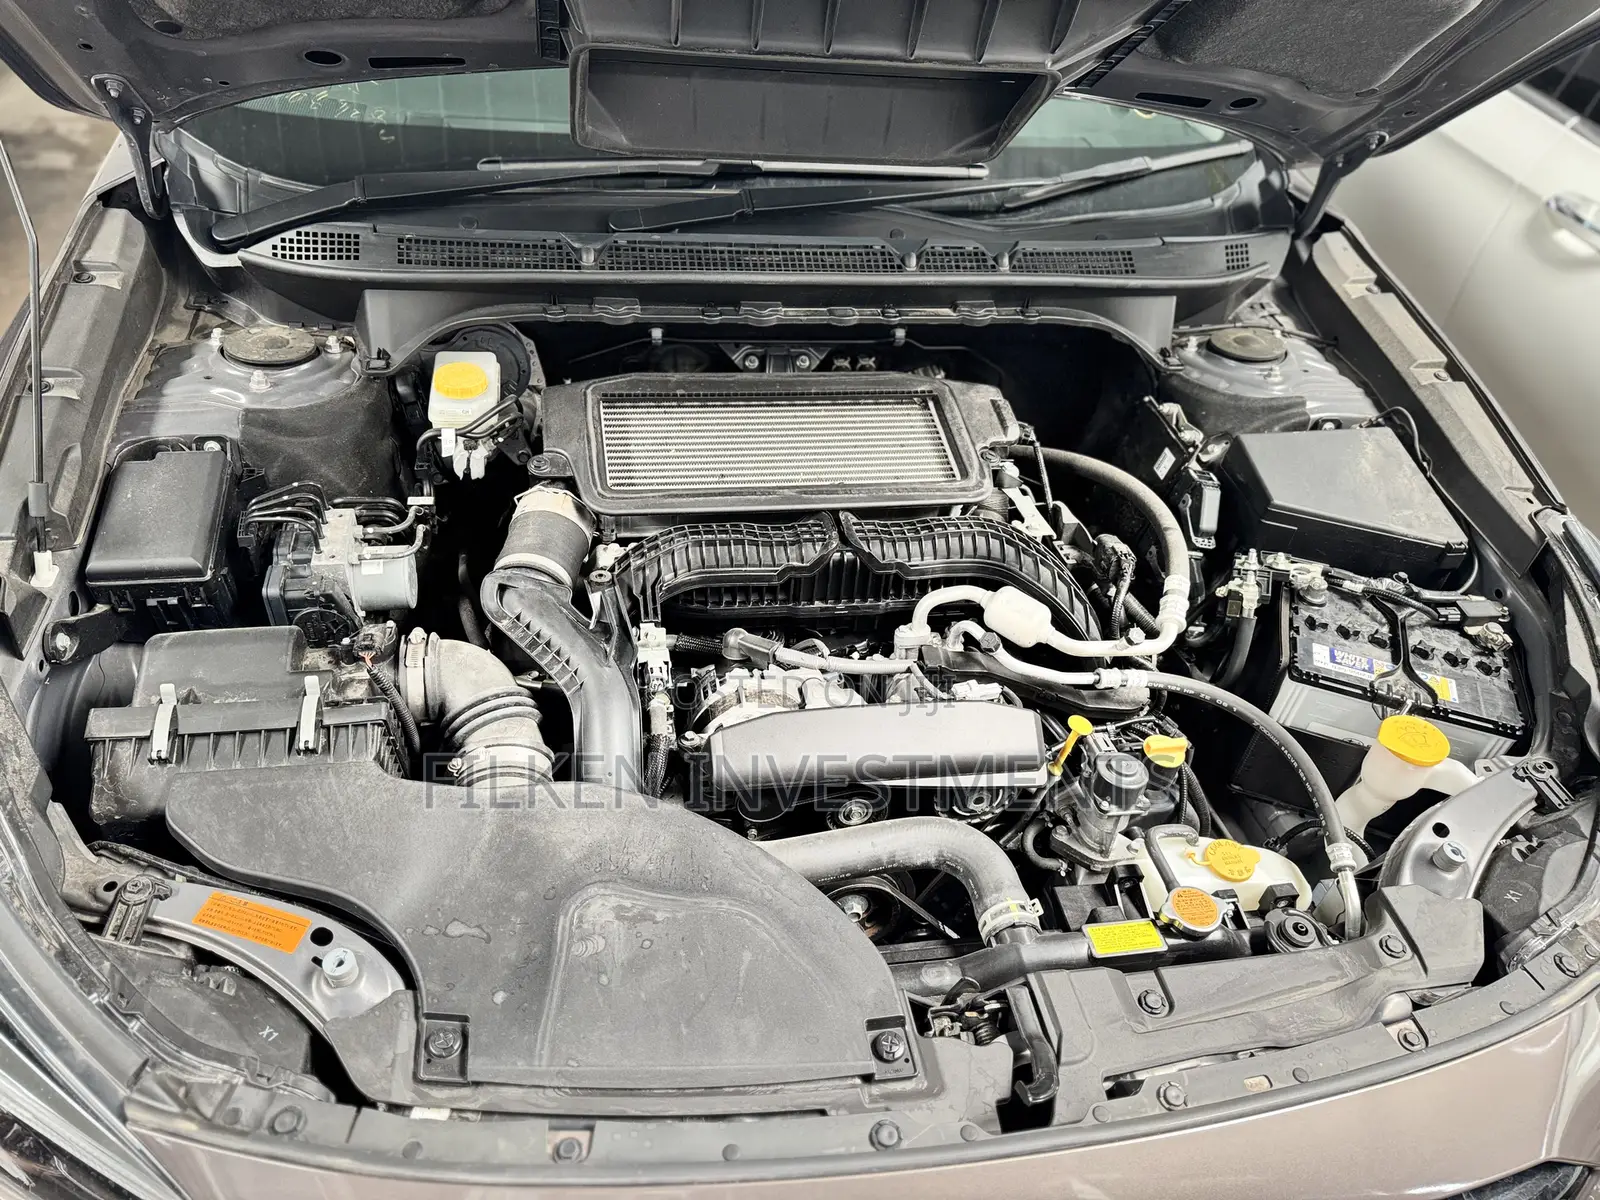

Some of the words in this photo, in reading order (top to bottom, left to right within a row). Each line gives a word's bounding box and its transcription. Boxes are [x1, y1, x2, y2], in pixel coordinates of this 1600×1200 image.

[1334, 649, 1368, 663] WHITE
[1503, 889, 1523, 903] X1
[258, 1025, 279, 1041] X1
